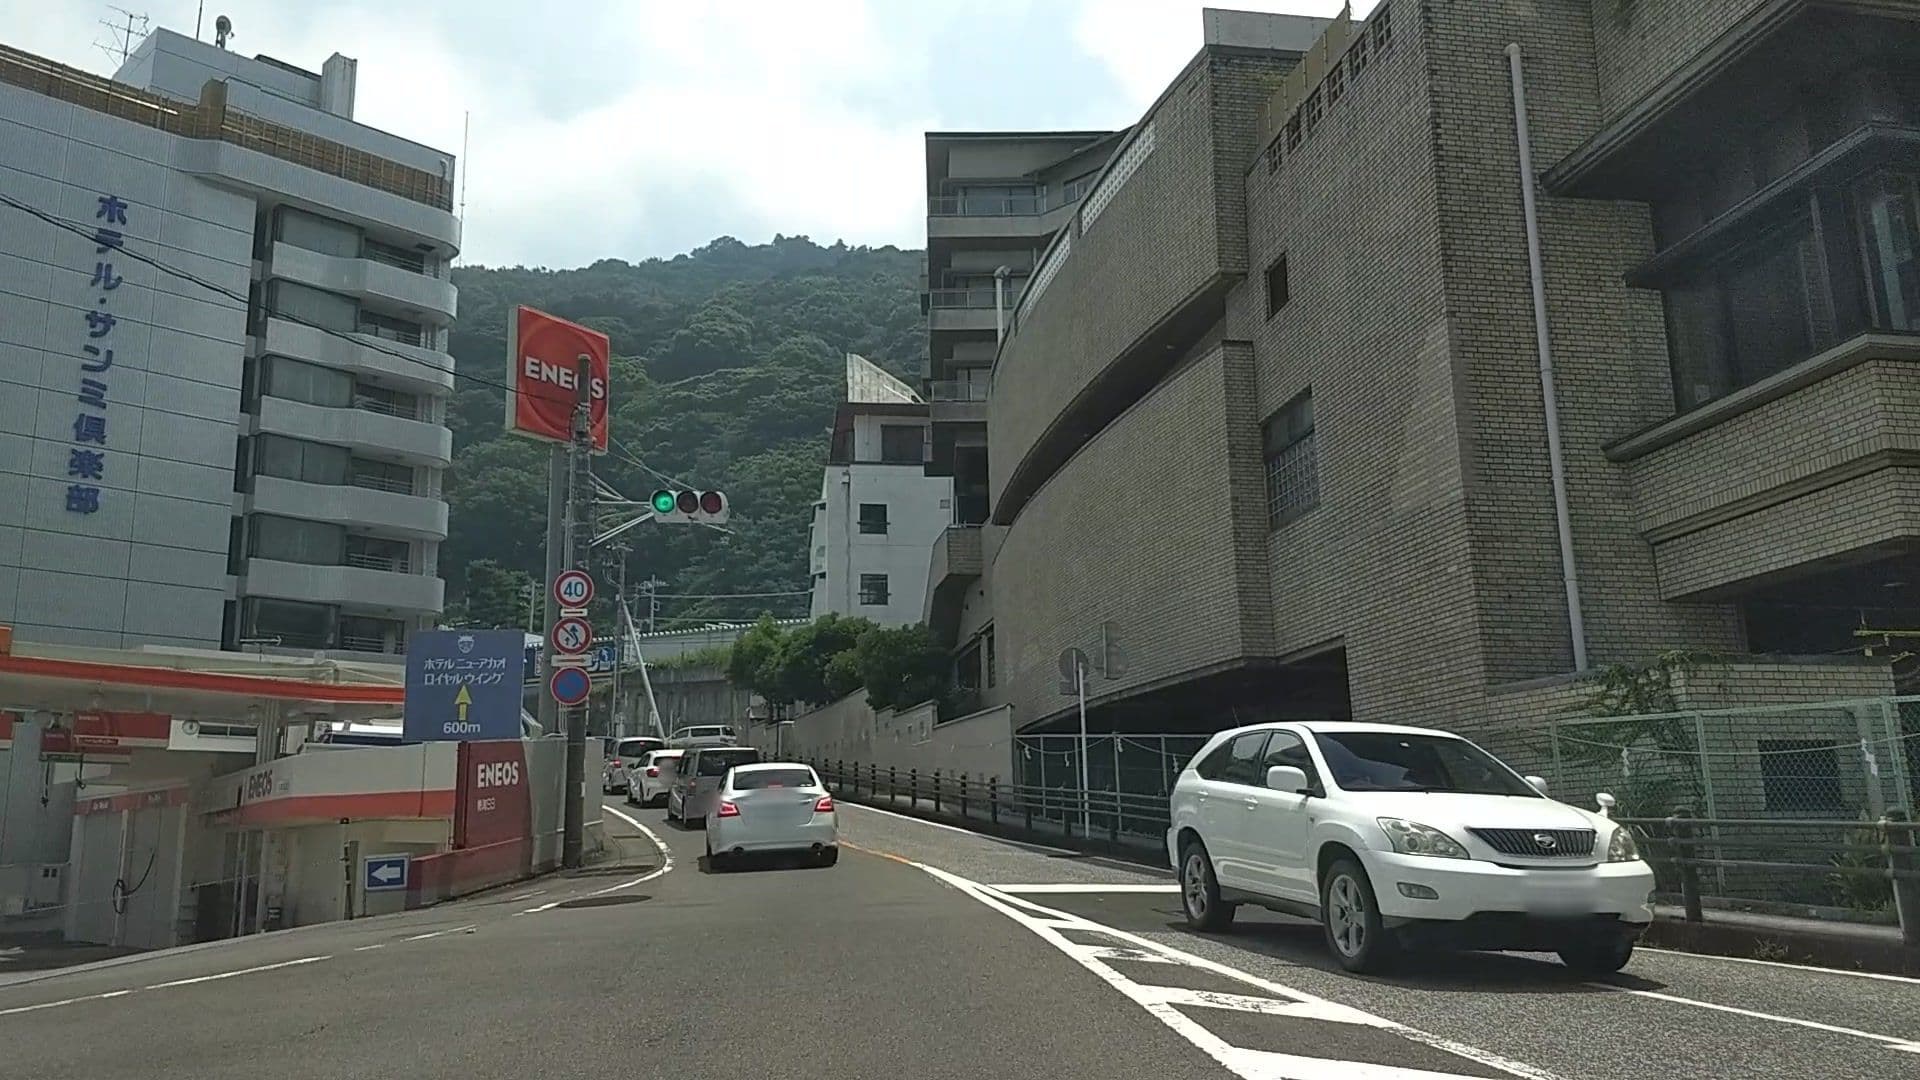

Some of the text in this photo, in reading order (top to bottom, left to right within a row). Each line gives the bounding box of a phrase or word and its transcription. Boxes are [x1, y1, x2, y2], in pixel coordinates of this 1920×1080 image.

[66, 195, 128, 515] ホテル・サンミ倶楽部
[564, 581, 584, 598] 40
[443, 722, 480, 734] 600m
[478, 762, 518, 788] ENEOS
